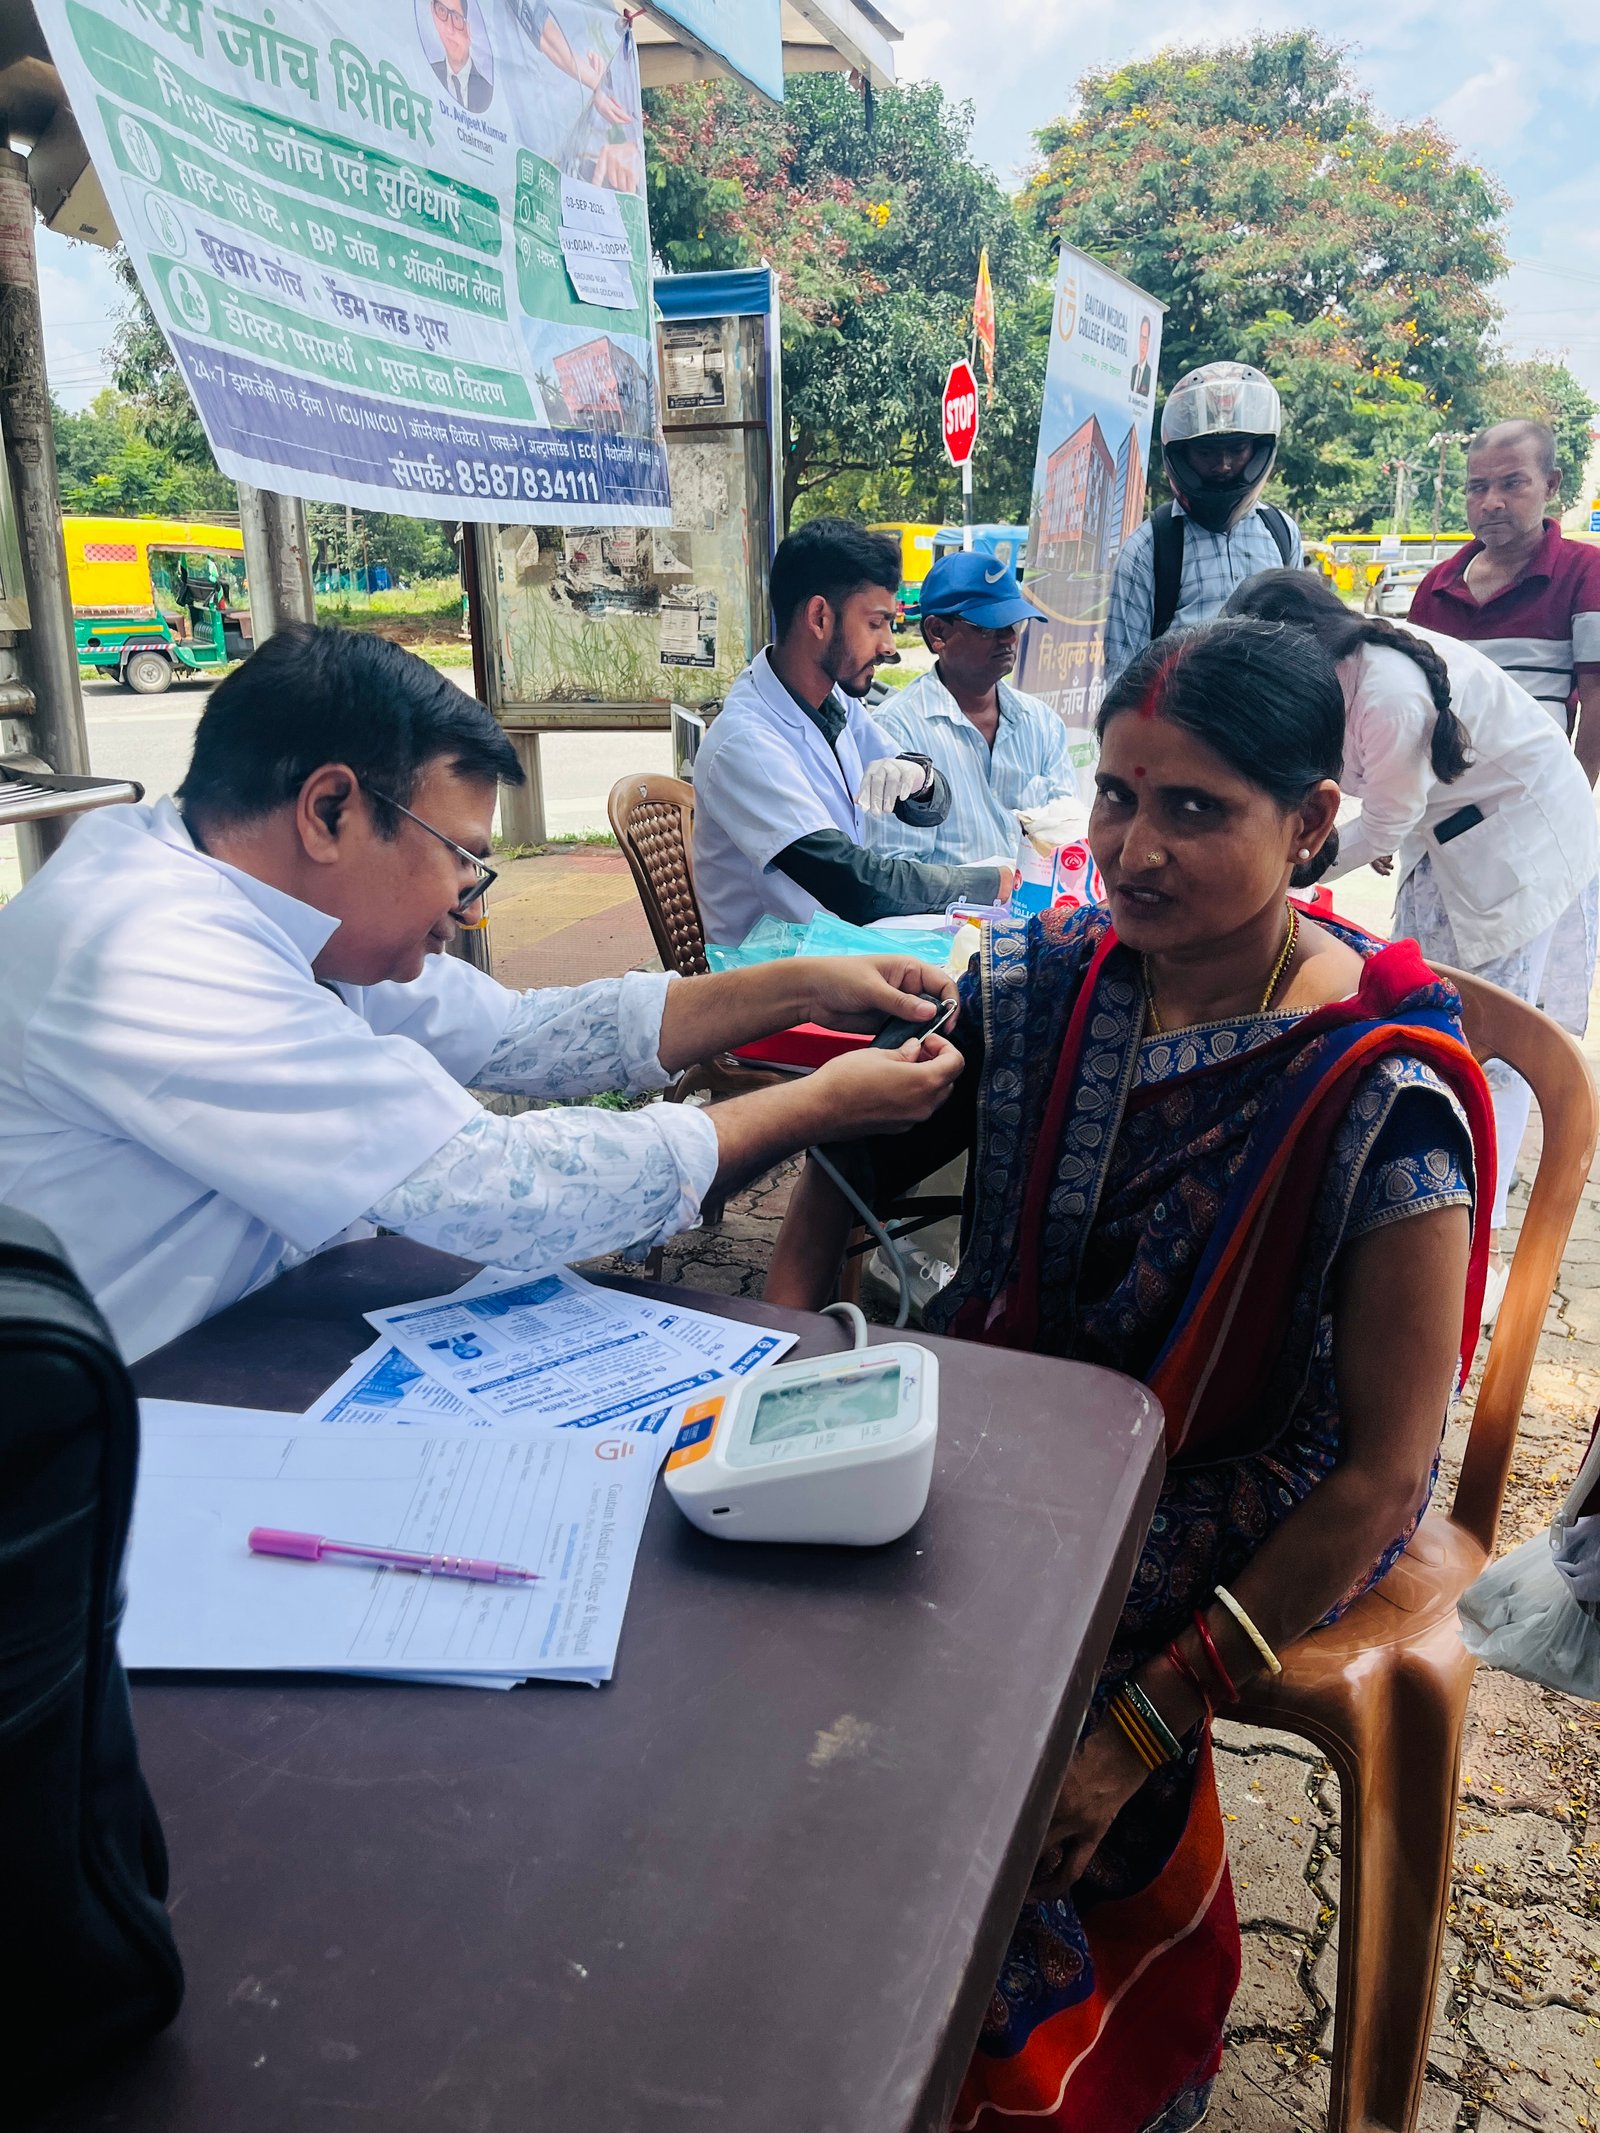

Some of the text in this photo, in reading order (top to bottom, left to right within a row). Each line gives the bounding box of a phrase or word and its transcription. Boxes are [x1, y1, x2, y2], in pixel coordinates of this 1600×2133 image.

[213, 6, 320, 101] जांच
[329, 38, 435, 148] शिविर
[439, 99, 508, 144] Dr. Avijeet Kumar
[457, 126, 494, 155] Chairman
[172, 153, 284, 234] हाइट एवं वेट
[263, 126, 326, 181] जांच
[330, 150, 368, 197] एवं
[196, 228, 452, 352] बुखार जांच रैंडम ब्लड शुगर
[306, 219, 502, 309] BP जांच ऑक्सीजन लेवल
[1078, 315, 1101, 344] COLLEGE
[1105, 330, 1128, 358] HOSPITAL
[1084, 293, 1128, 334] GAUTAM MEDICAL
[219, 292, 507, 407] डॉक्टर परामर्श मुफ्त दवा वितरण
[279, 385, 299, 410] एवं
[298, 389, 326, 418] ट्रॉमा
[336, 403, 398, 434] ICU/NICU
[408, 418, 449, 445] ऑपरेशन
[450, 425, 480, 448] थियेटर
[489, 434, 520, 453] एक्स-रे
[578, 443, 596, 459] ECG
[604, 442, 634, 464] पैथोलॉजी
[946, 392, 974, 435] STOP
[388, 451, 599, 500] संपर्क: 8587834111
[1060, 676, 1088, 716] जांच
[573, 1483, 623, 1656] Gautam Medical College & Hospital
